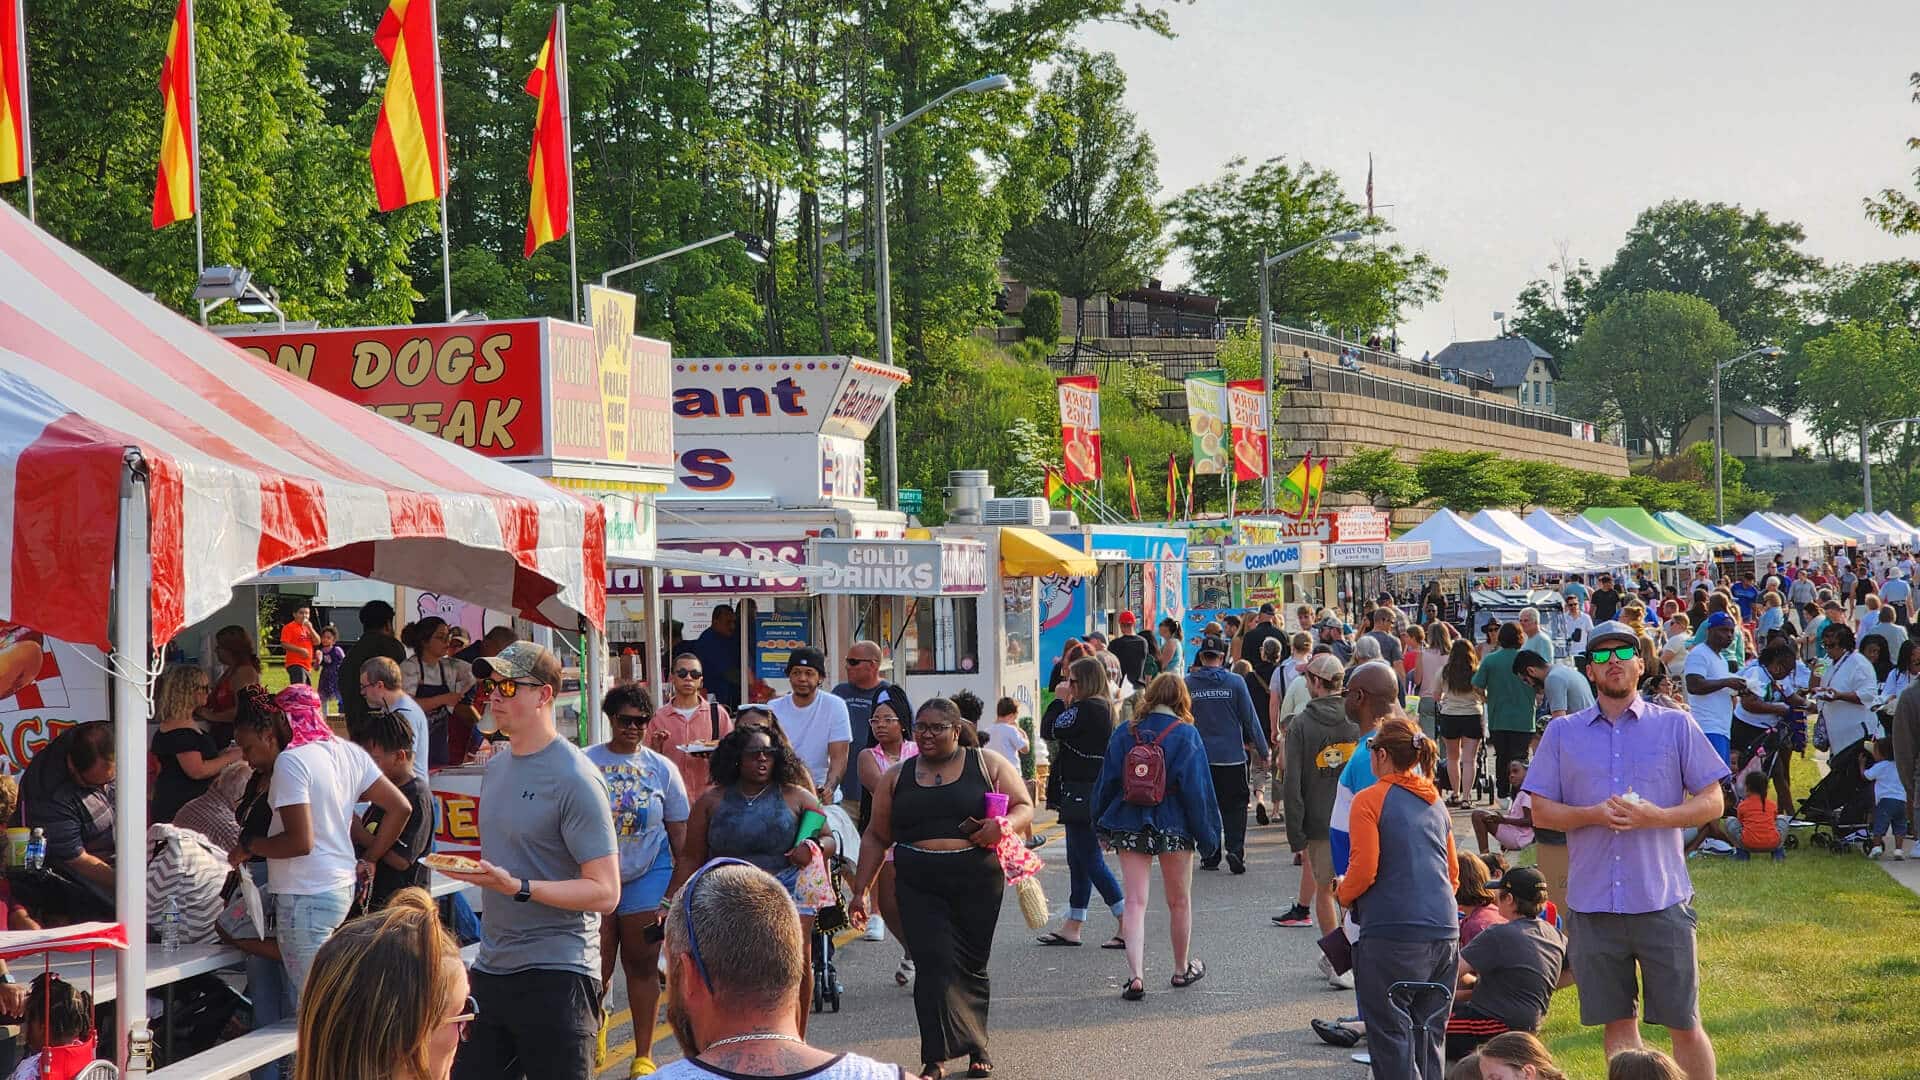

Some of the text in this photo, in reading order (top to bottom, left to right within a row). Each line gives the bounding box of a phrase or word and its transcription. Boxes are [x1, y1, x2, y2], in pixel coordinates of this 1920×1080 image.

[351, 333, 513, 389] DOGS
[556, 335, 591, 385] POLISH
[365, 397, 522, 449] EAK
[555, 399, 601, 448] SAUSAGE
[833, 378, 887, 424] Elephant
[822, 437, 862, 497] Ears
[822, 560, 933, 589] DRINKS
[848, 547, 908, 566] COLD
